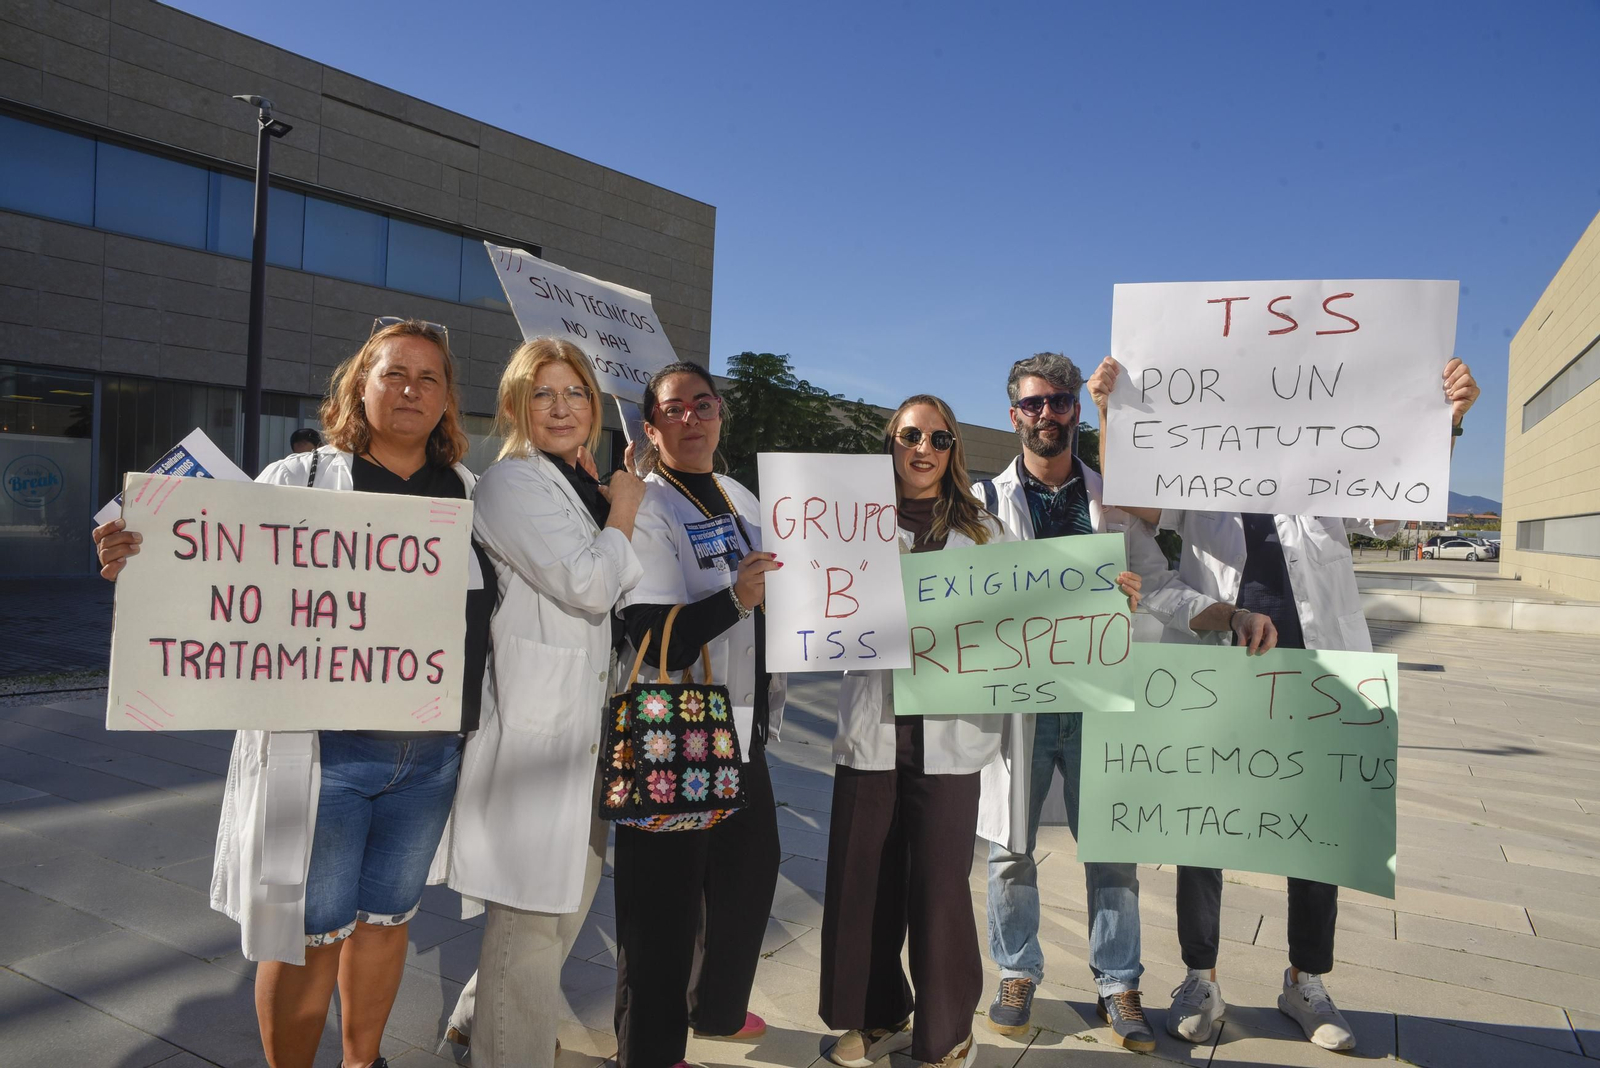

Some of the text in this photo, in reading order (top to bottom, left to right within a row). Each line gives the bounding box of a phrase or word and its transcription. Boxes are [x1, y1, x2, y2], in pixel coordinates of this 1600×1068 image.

[1207, 292, 1360, 337] TSS
[561, 317, 631, 354] NO HAY
[1141, 362, 1344, 405] POR UN
[1133, 420, 1381, 451] ESTATUTO
[8, 472, 59, 492] Break
[1155, 474, 1278, 498] MARCO
[772, 496, 898, 543] GRUPO
[694, 539, 727, 558] HUELGA
[210, 584, 367, 631] NO HAY
[910, 612, 1131, 676] RESPETO
[983, 681, 1057, 706] TSS
[1105, 742, 1395, 790] HACEMOS TUS
